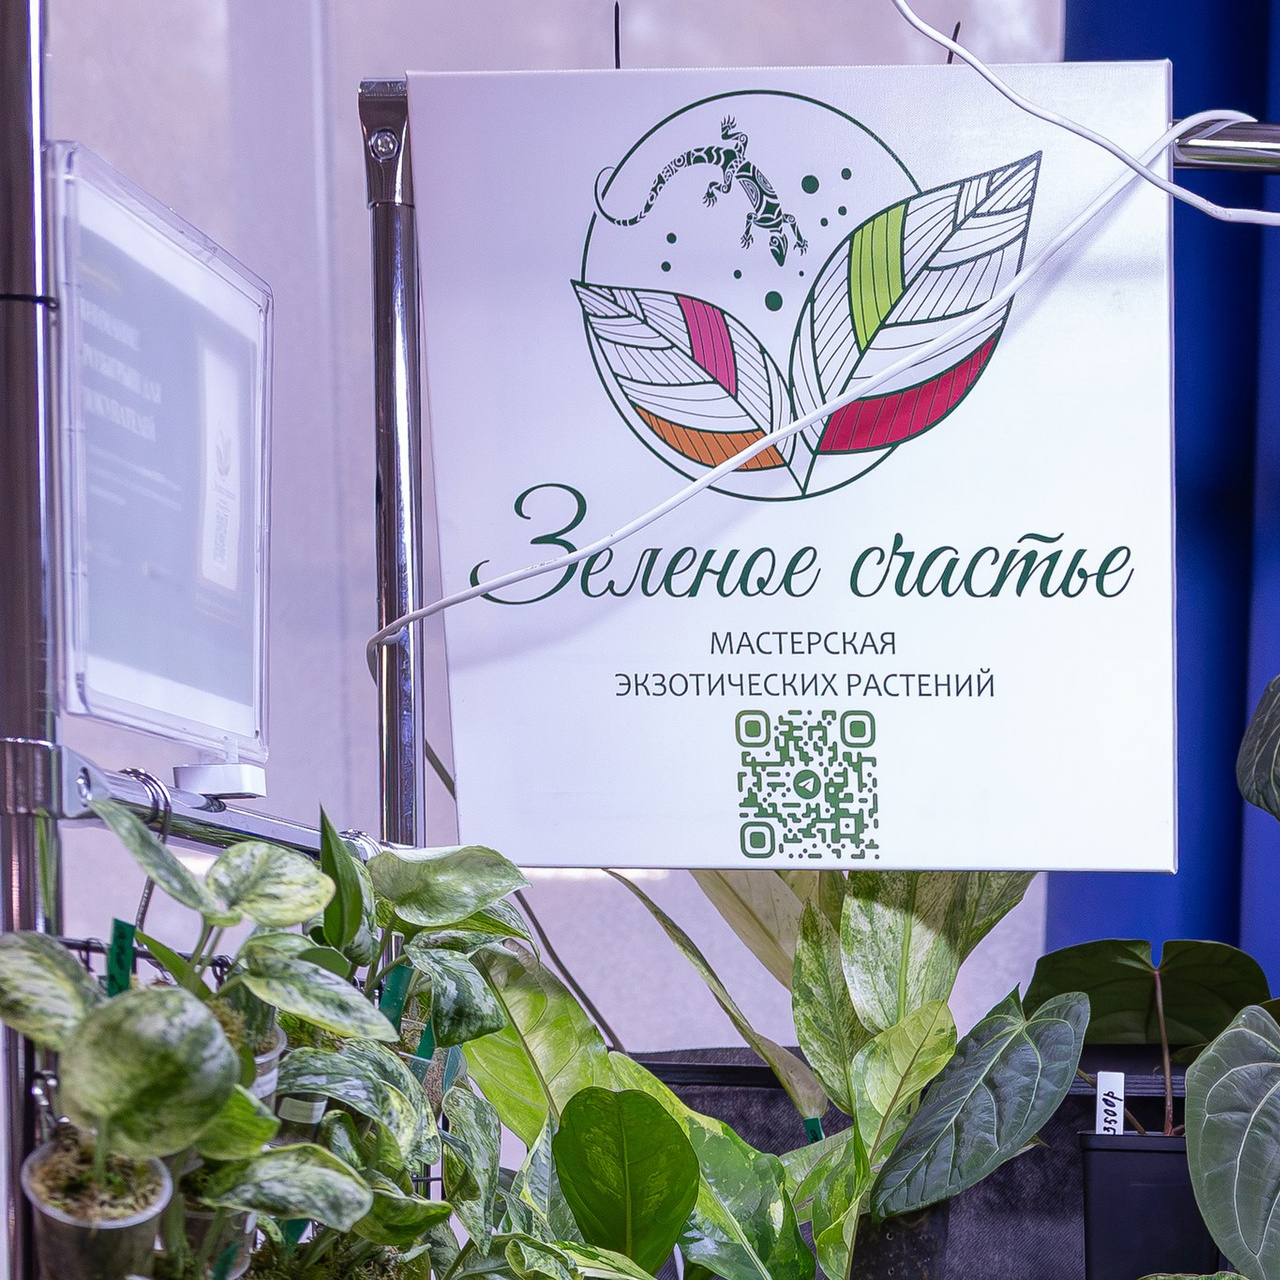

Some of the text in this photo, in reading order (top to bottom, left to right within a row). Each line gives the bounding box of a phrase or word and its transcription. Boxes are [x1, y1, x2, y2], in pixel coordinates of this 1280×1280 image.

[469, 482, 1135, 606] Зеленое счастье
[709, 631, 897, 656] МАСТЕРСКАЯ
[614, 667, 996, 699] ЭКЗОТИЧЕСКИХ РАСТЕНИЙ
